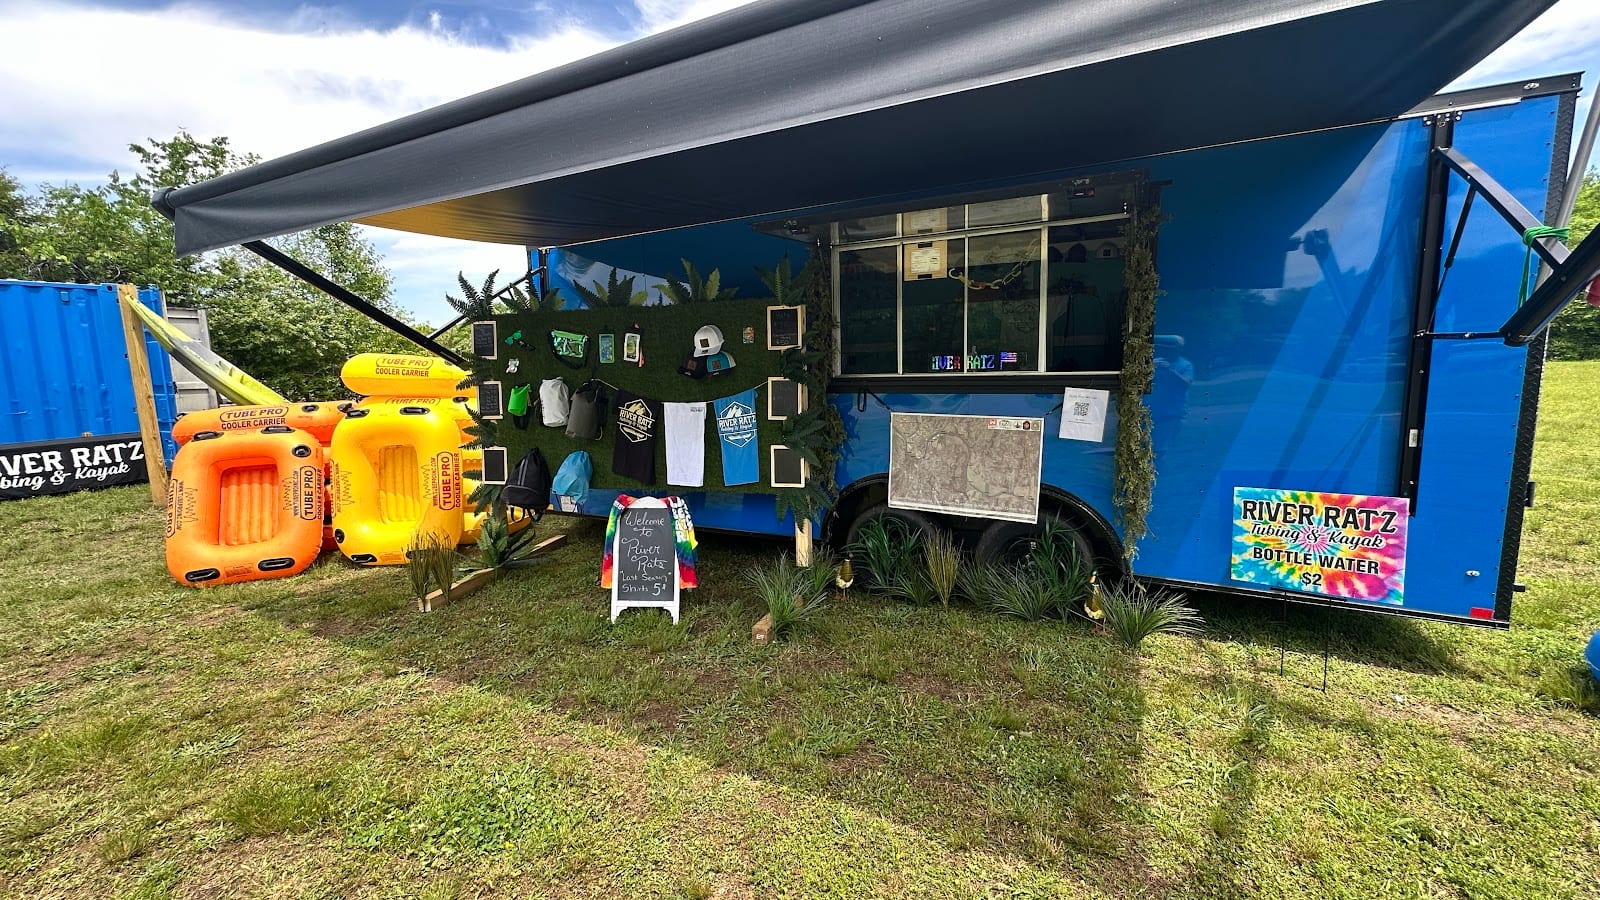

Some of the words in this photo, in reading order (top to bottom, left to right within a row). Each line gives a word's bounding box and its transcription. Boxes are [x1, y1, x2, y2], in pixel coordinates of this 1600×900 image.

[375, 367, 400, 376] COOLER
[401, 368, 430, 378] CARRIER
[381, 357, 406, 367] TUBE
[408, 359, 429, 368] PRO
[221, 420, 252, 430] COOLER
[253, 417, 286, 427] CARRIER
[226, 410, 257, 419] TUBE
[259, 408, 283, 416] PRO
[619, 409, 637, 422] RIVER
[719, 418, 738, 430] RIVER
[738, 414, 757, 426] RATZ
[0, 451, 65, 476] VER
[70, 441, 145, 468] RATZ
[441, 456, 451, 477] PRO
[453, 453, 461, 481] CARRIER
[50, 470, 71, 485] &
[75, 462, 131, 481] Kayak
[304, 470, 314, 489] PRO
[442, 478, 452, 506] TUBE
[453, 482, 461, 508] COOLER
[304, 490, 314, 516] TUBE
[624, 511, 665, 527] Welcome
[1242, 500, 1315, 526] RIVER
[1323, 506, 1399, 534] RATZ
[633, 526, 654, 537] to
[1251, 523, 1301, 543] Tubing
[1306, 529, 1321, 543] &
[1328, 531, 1384, 550] Kayak
[621, 537, 661, 558] River
[1253, 547, 1313, 566] BOTTLE
[1318, 554, 1379, 575] WATER
[622, 583, 649, 593] Shirts
[1301, 571, 1322, 587] $2
